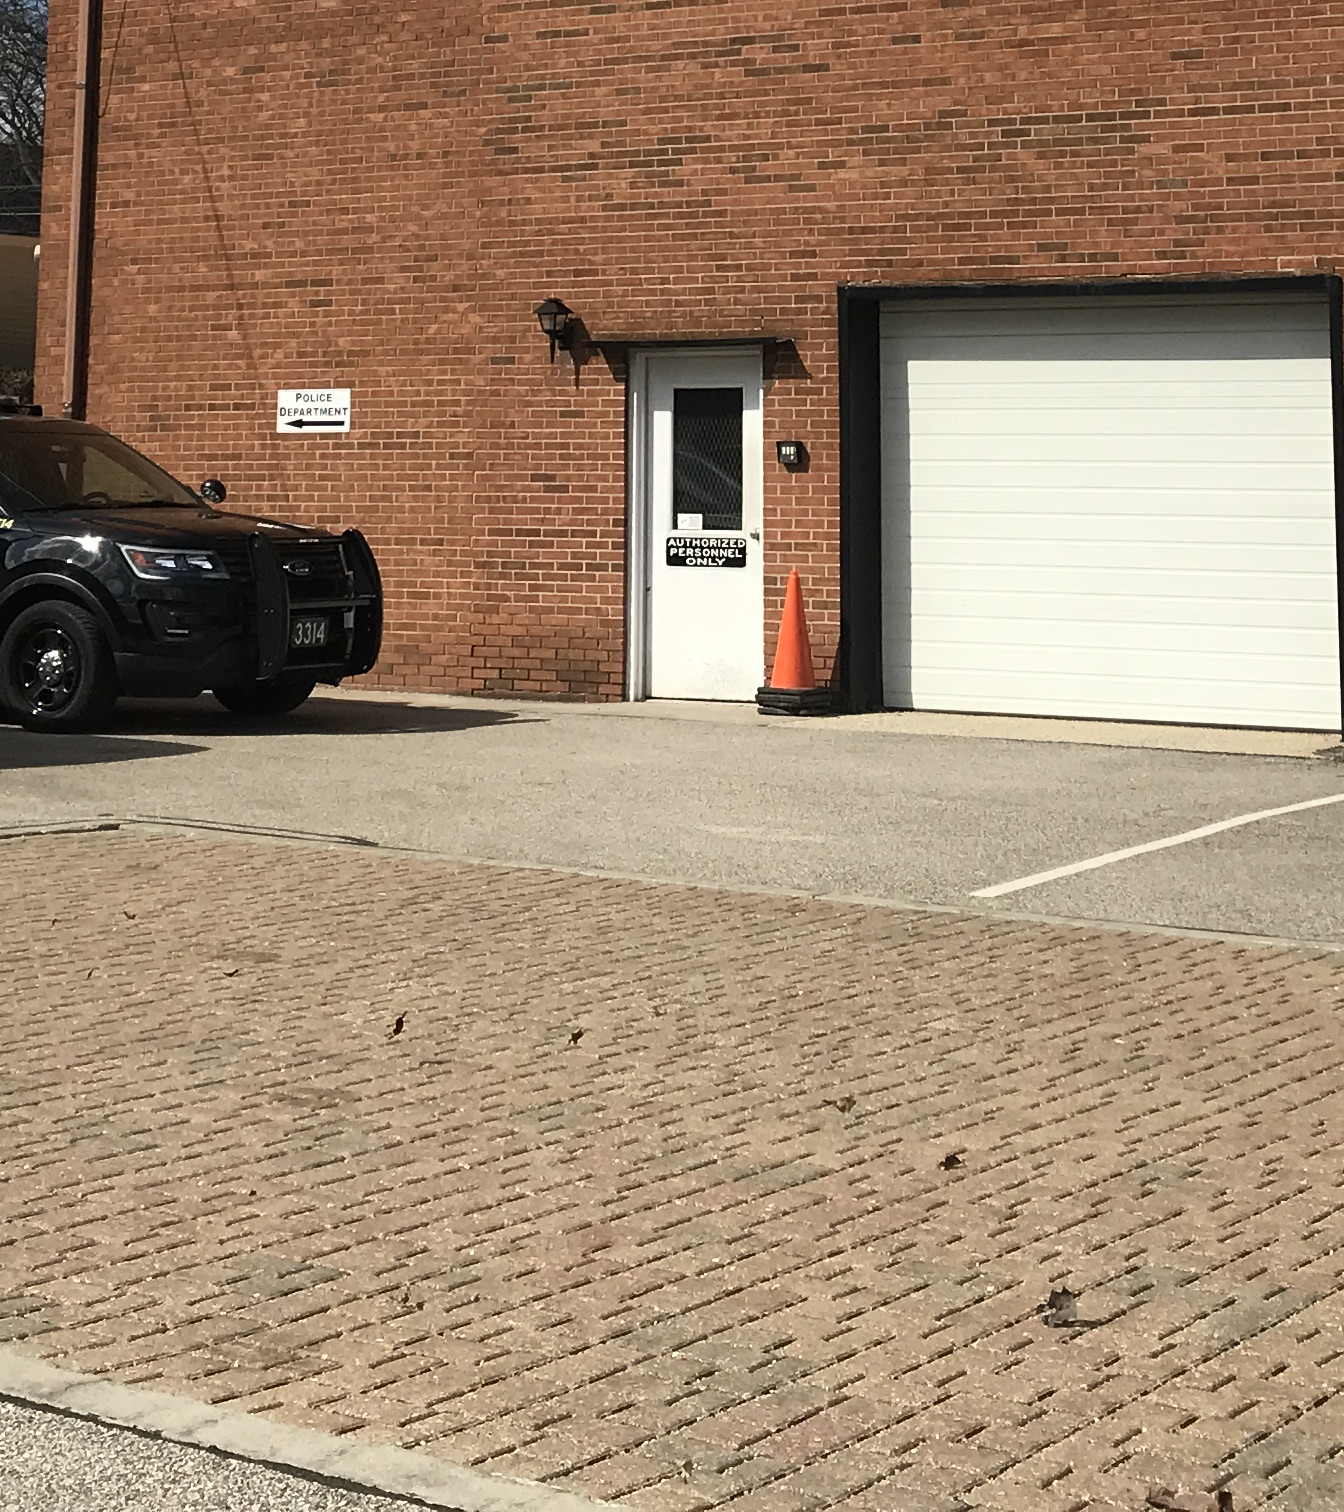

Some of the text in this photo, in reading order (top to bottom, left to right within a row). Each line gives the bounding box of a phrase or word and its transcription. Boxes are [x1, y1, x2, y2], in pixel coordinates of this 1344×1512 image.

[296, 393, 332, 403] POLICE
[279, 407, 348, 417] DEPARTMENT
[667, 538, 746, 548] AUTHORIZED
[669, 548, 743, 558] PERSONNEL
[685, 557, 726, 566] ONLY
[294, 622, 325, 645] 3314
